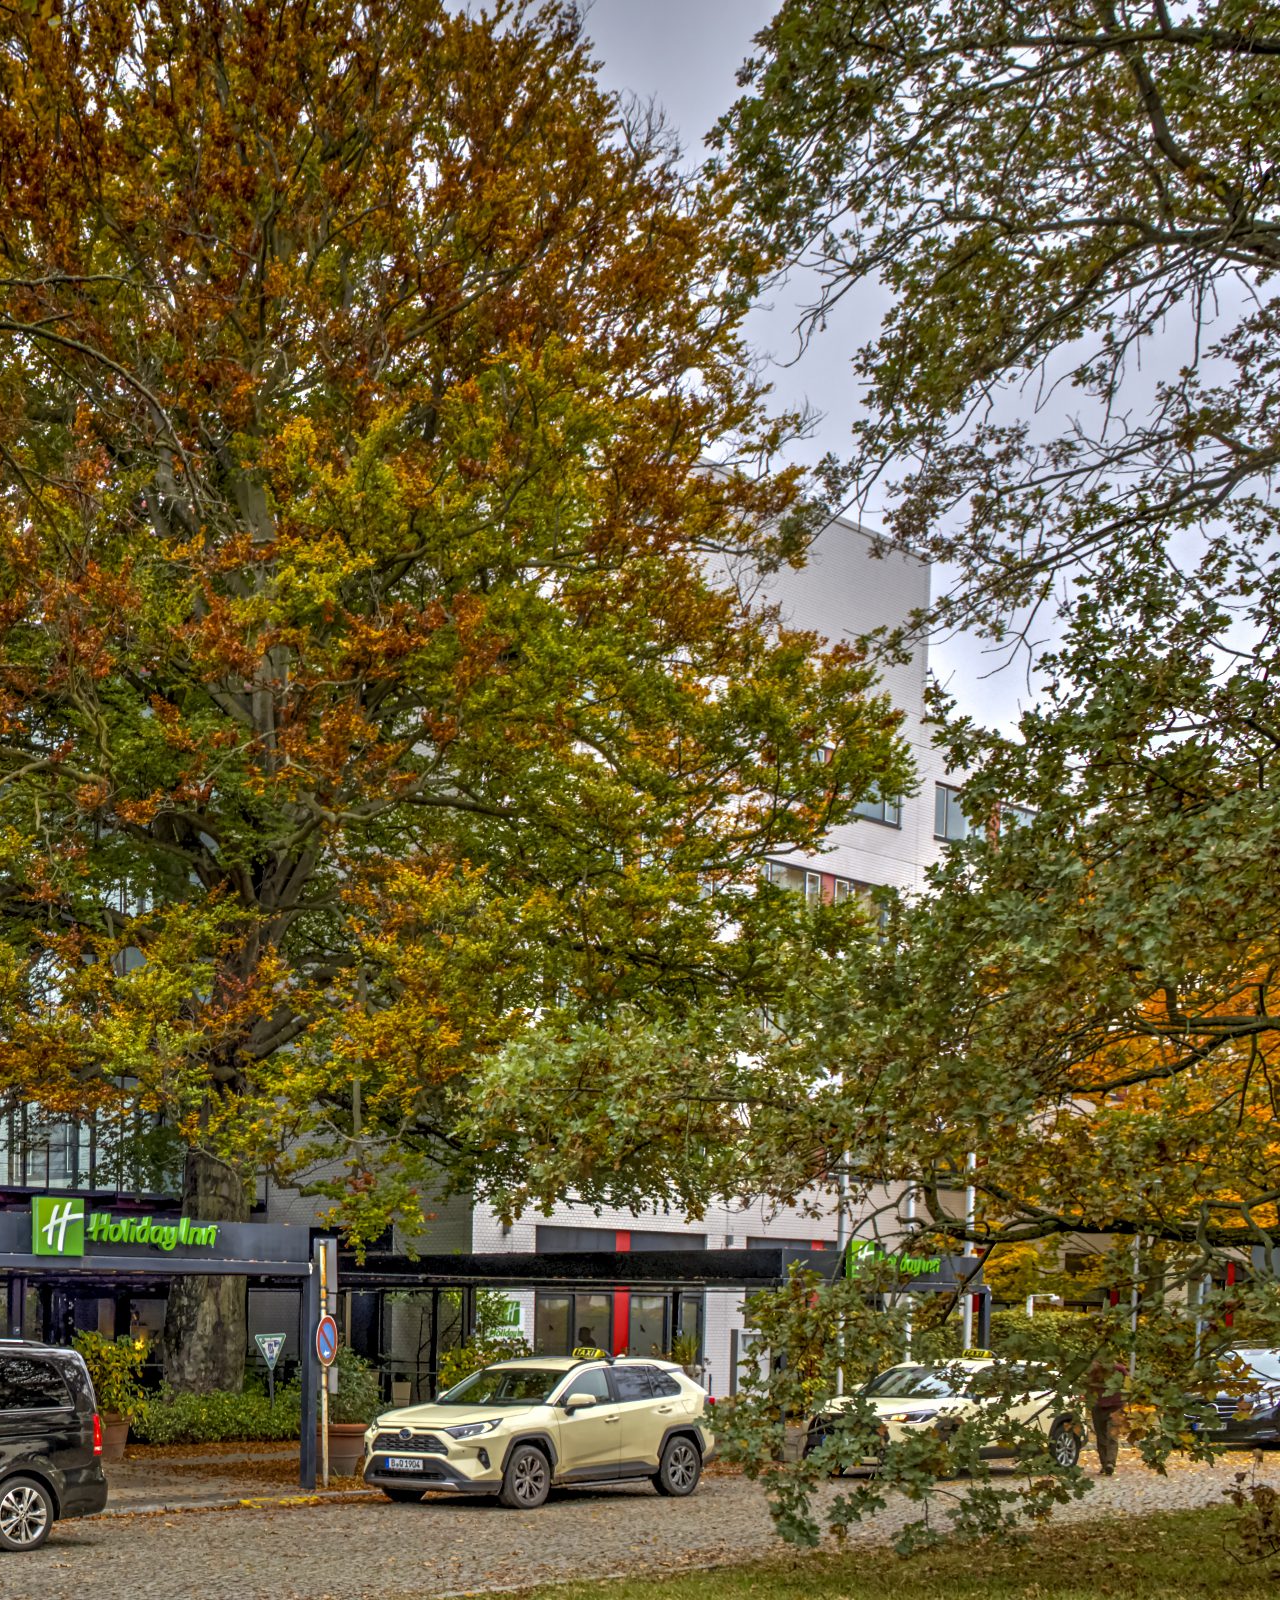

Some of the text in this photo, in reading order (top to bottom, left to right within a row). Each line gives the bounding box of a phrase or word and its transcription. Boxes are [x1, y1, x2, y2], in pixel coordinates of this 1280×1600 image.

[87, 1213, 218, 1251] Holiday Inn
[574, 1349, 597, 1358] TAXI
[964, 1350, 985, 1358] TAXI
